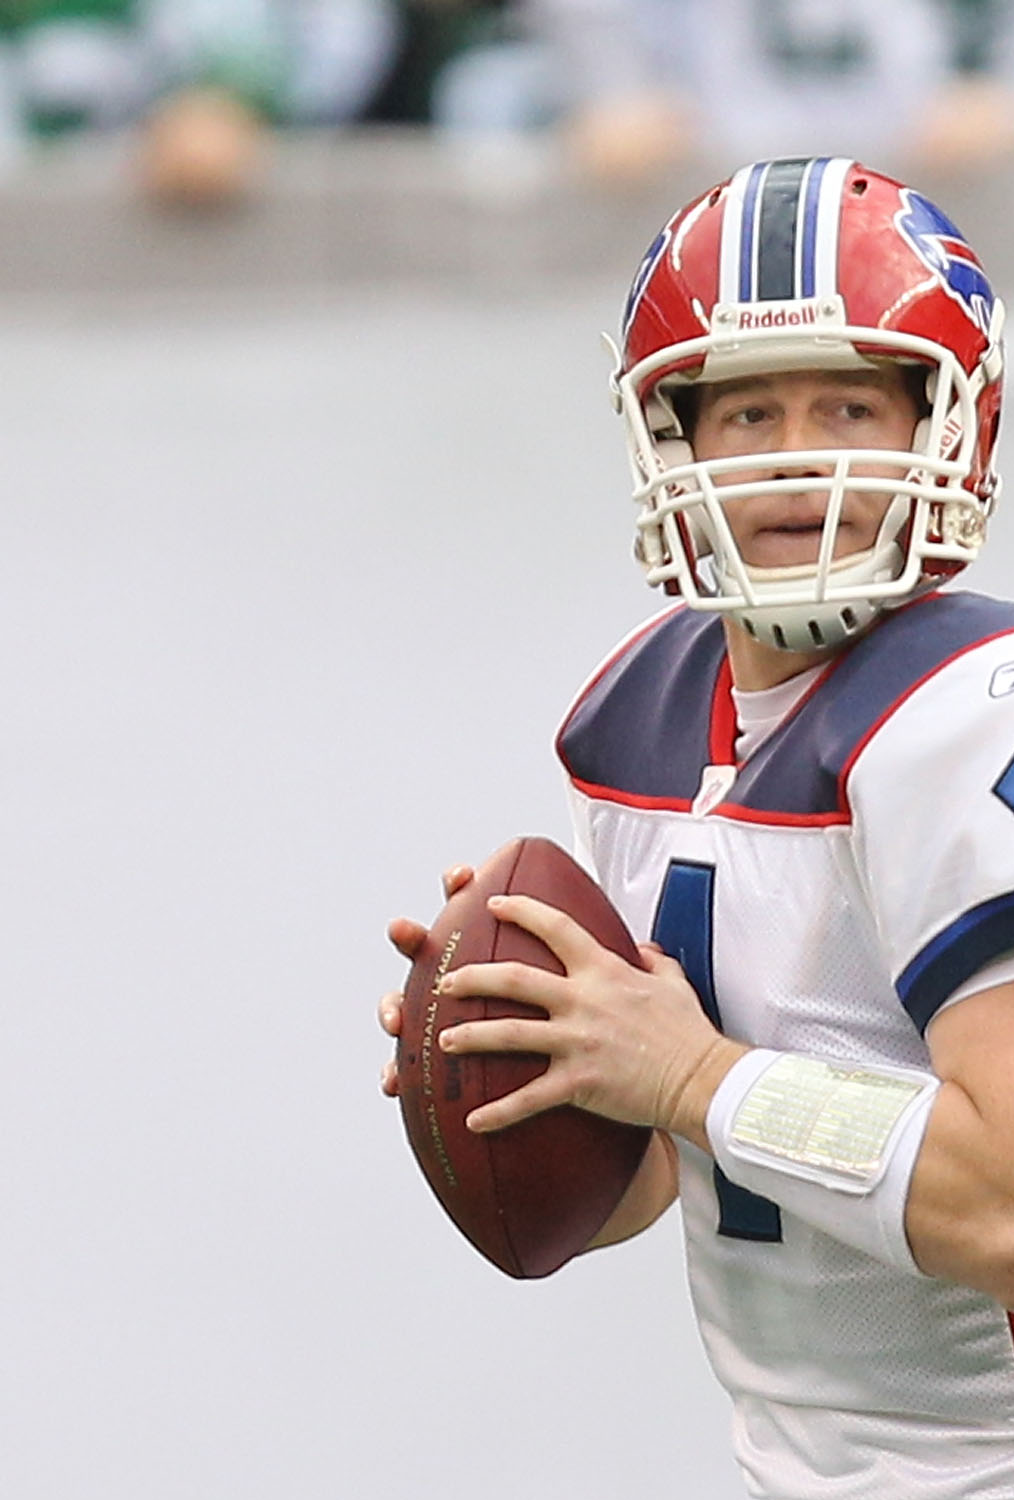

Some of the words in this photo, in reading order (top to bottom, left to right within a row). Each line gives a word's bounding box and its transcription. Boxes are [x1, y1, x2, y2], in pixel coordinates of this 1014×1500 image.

[738, 303, 816, 329] Riddell
[422, 1001, 438, 1095] FOOTBALL
[431, 930, 462, 996] LEAGUE
